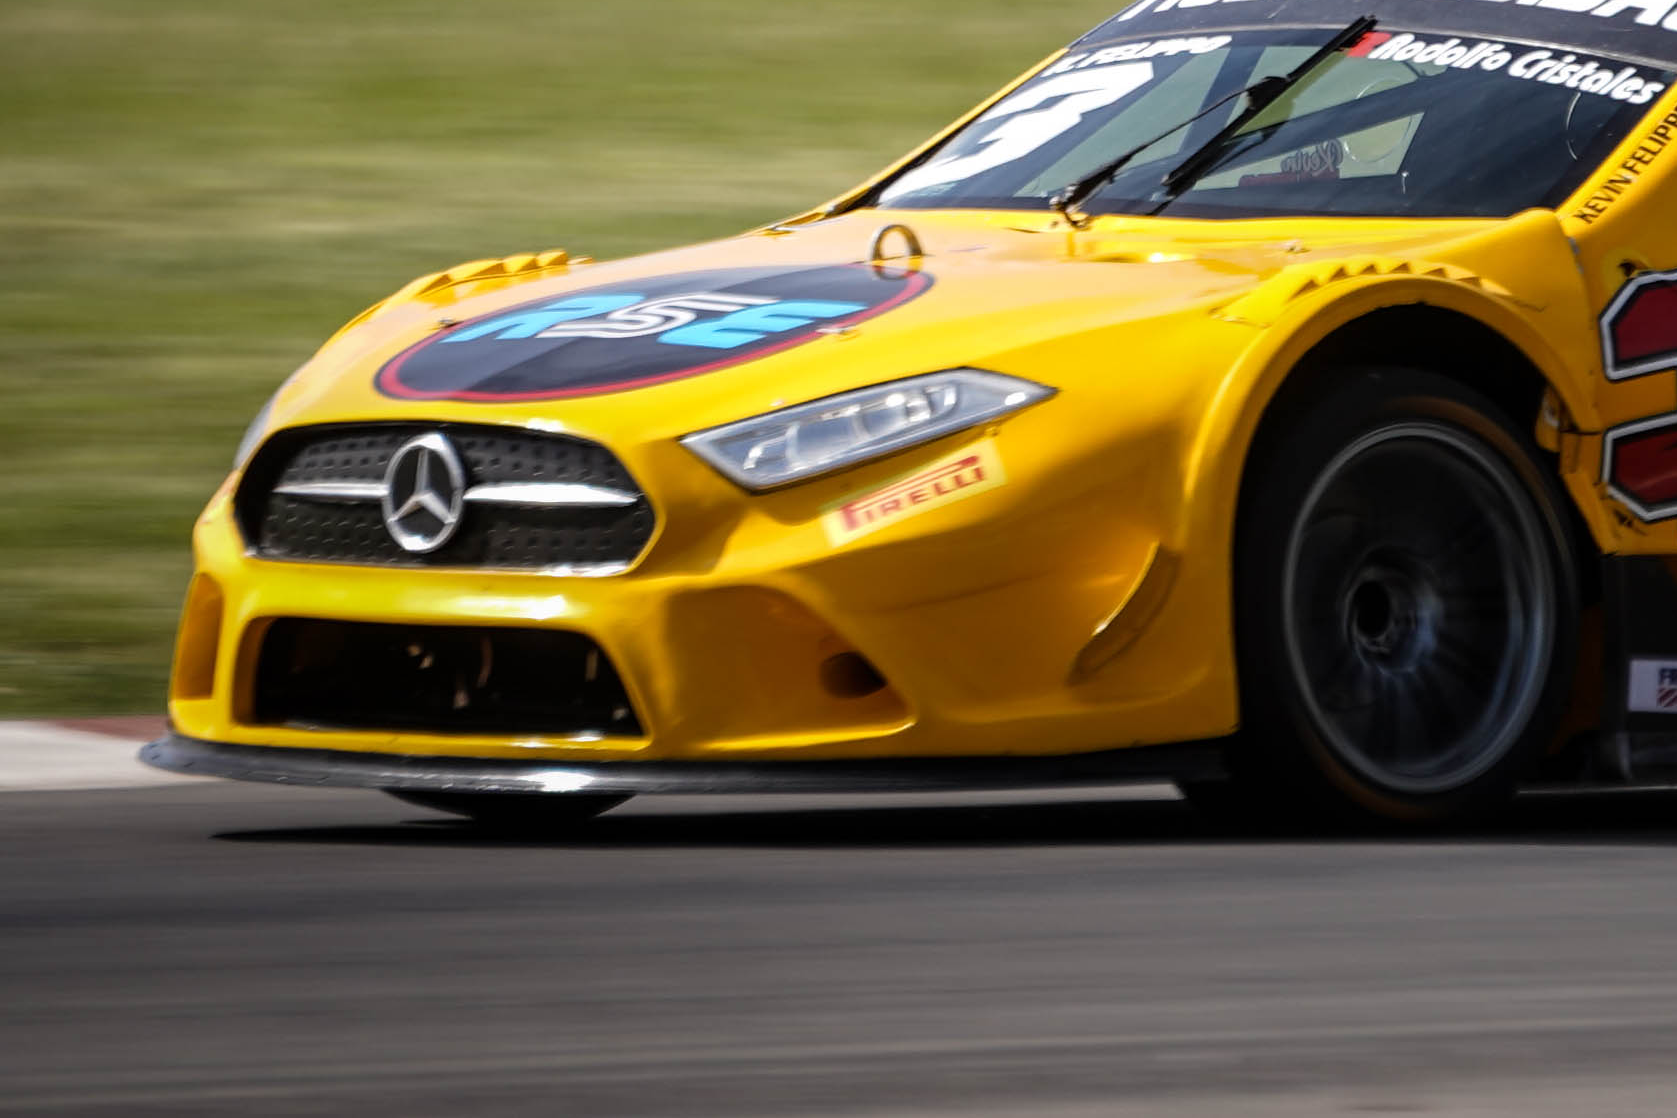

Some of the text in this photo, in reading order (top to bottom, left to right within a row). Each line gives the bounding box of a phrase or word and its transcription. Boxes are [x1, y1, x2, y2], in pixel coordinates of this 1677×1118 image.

[1367, 33, 1666, 105] Rodolfo Cristales
[1573, 174, 1634, 225] KEVIN
[841, 455, 986, 532] PIRELLI
